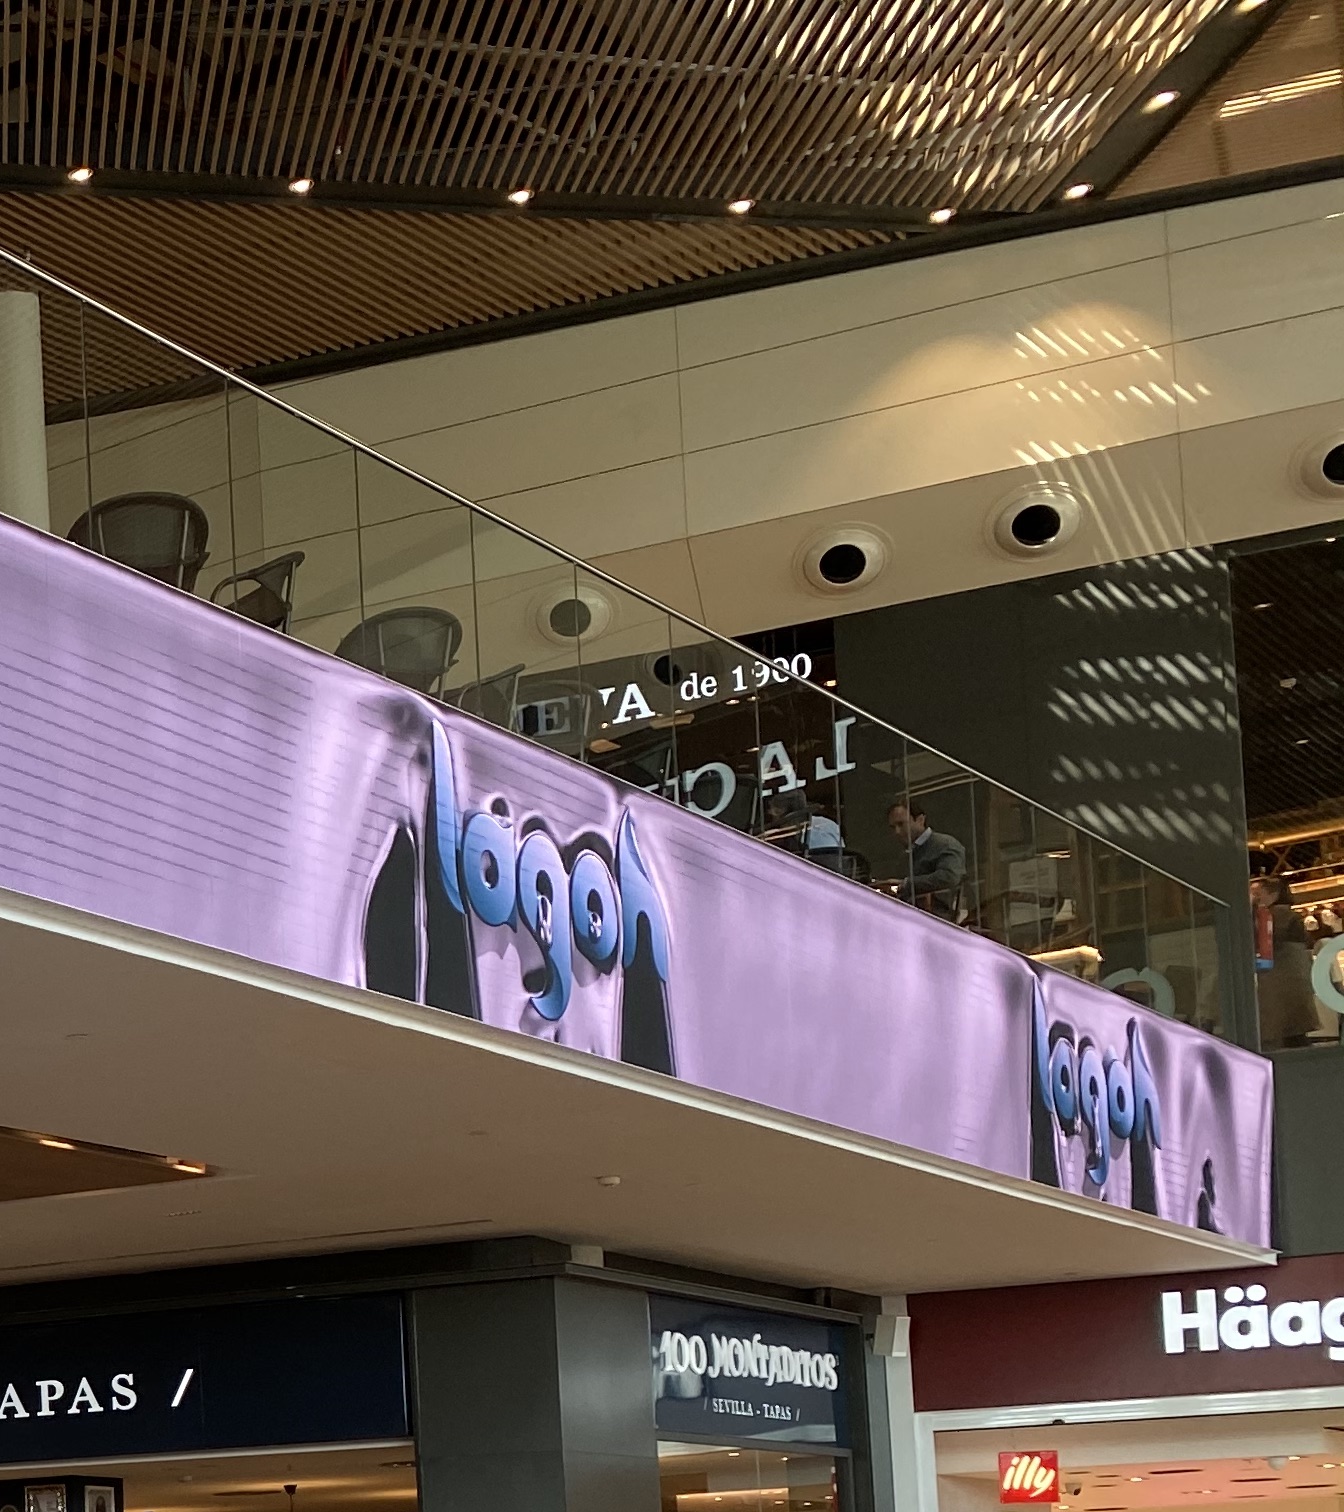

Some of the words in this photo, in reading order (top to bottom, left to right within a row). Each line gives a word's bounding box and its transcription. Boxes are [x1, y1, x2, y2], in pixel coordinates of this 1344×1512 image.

[680, 673, 718, 701] de
[432, 718, 668, 1021] lagoh
[1033, 976, 1162, 1186] lagoh
[659, 1331, 707, 1375] 100
[708, 1333, 839, 1391] MONTADITOS
[712, 1398, 754, 1416] SEVILLA
[762, 1403, 792, 1421] TAPAS
[1002, 1455, 1055, 1498] illy
